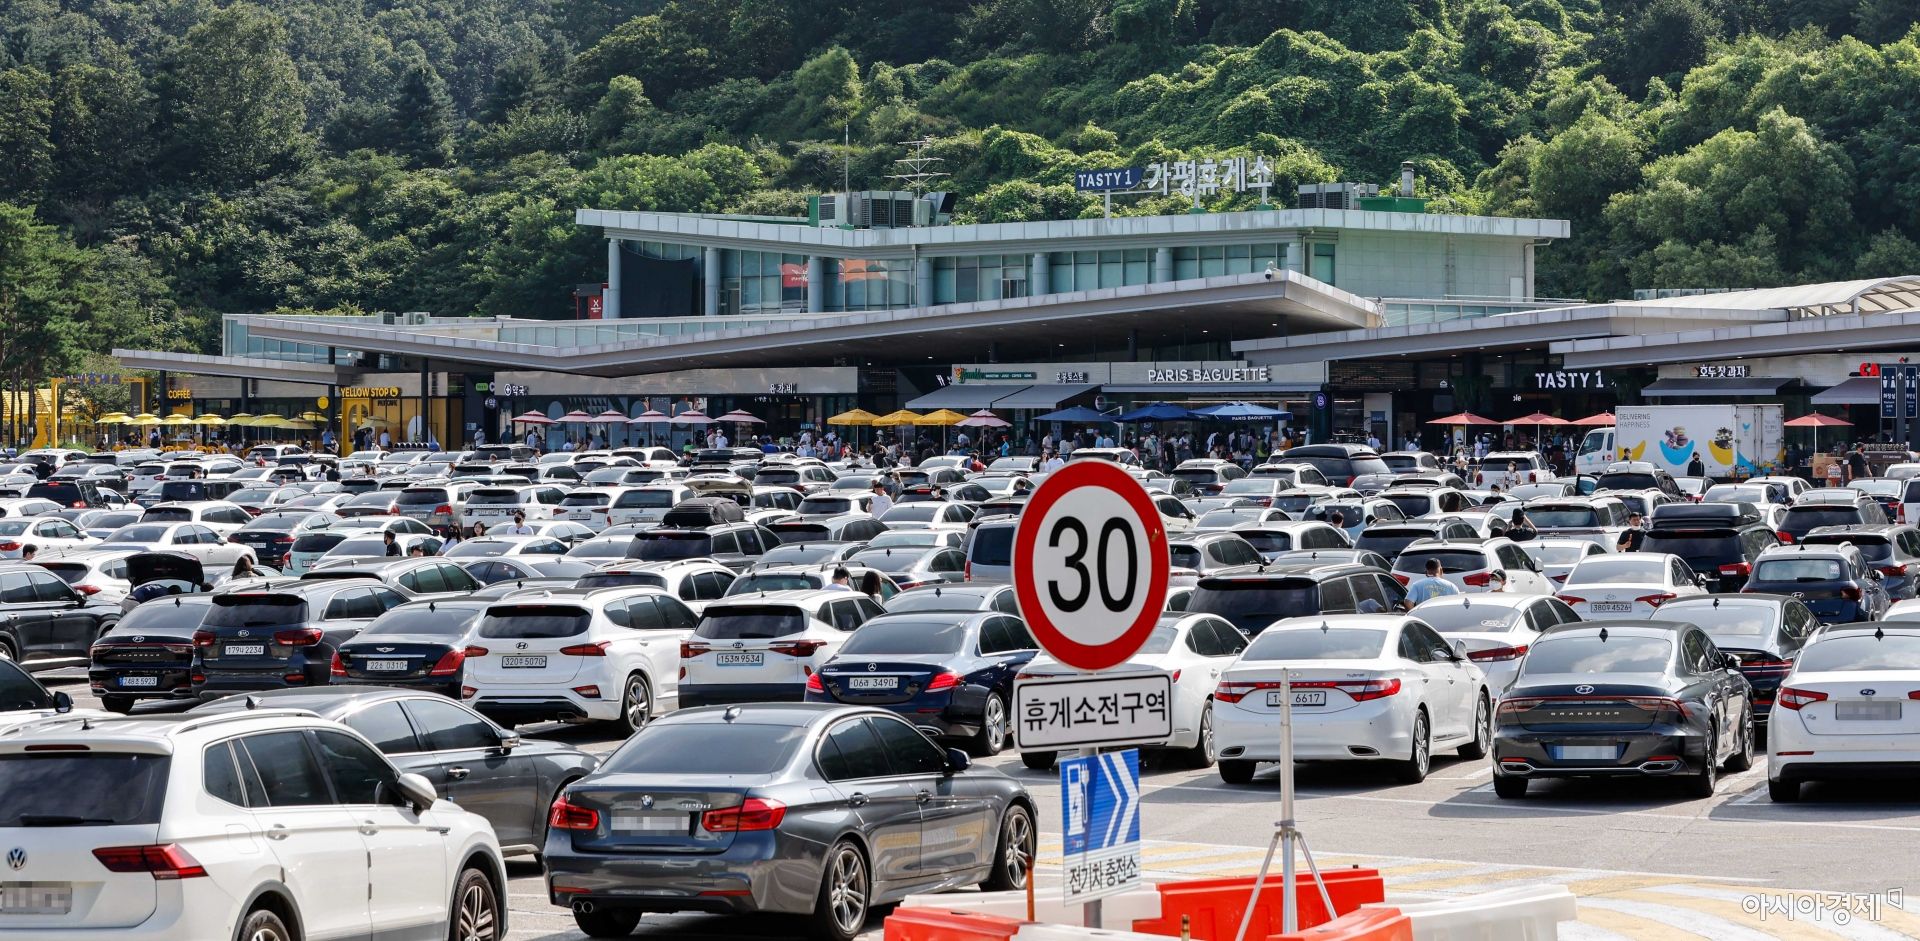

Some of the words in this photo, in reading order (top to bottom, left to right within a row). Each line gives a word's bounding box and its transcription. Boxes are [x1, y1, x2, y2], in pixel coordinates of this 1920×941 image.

[1079, 173, 1120, 187] TASTY
[1125, 170, 1131, 185] 1
[1146, 156, 1273, 196] 가평휴게소
[1148, 369, 1188, 382] PARIS
[1192, 367, 1268, 382] BAGUETTE
[1535, 371, 1590, 389] TASTY
[1595, 370, 1604, 389] 1
[168, 390, 191, 399] COFFEE
[340, 387, 369, 398] YELLOW
[370, 387, 389, 398] STOP
[1619, 421, 1650, 429] HAPPINESS
[1047, 516, 1138, 613] 30
[872, 678, 894, 688] 3490
[1295, 693, 1320, 704] 6617
[1024, 690, 1167, 731] 휴게소전구역
[1069, 860, 1104, 895] 전기차
[1105, 854, 1138, 887] 충전소
